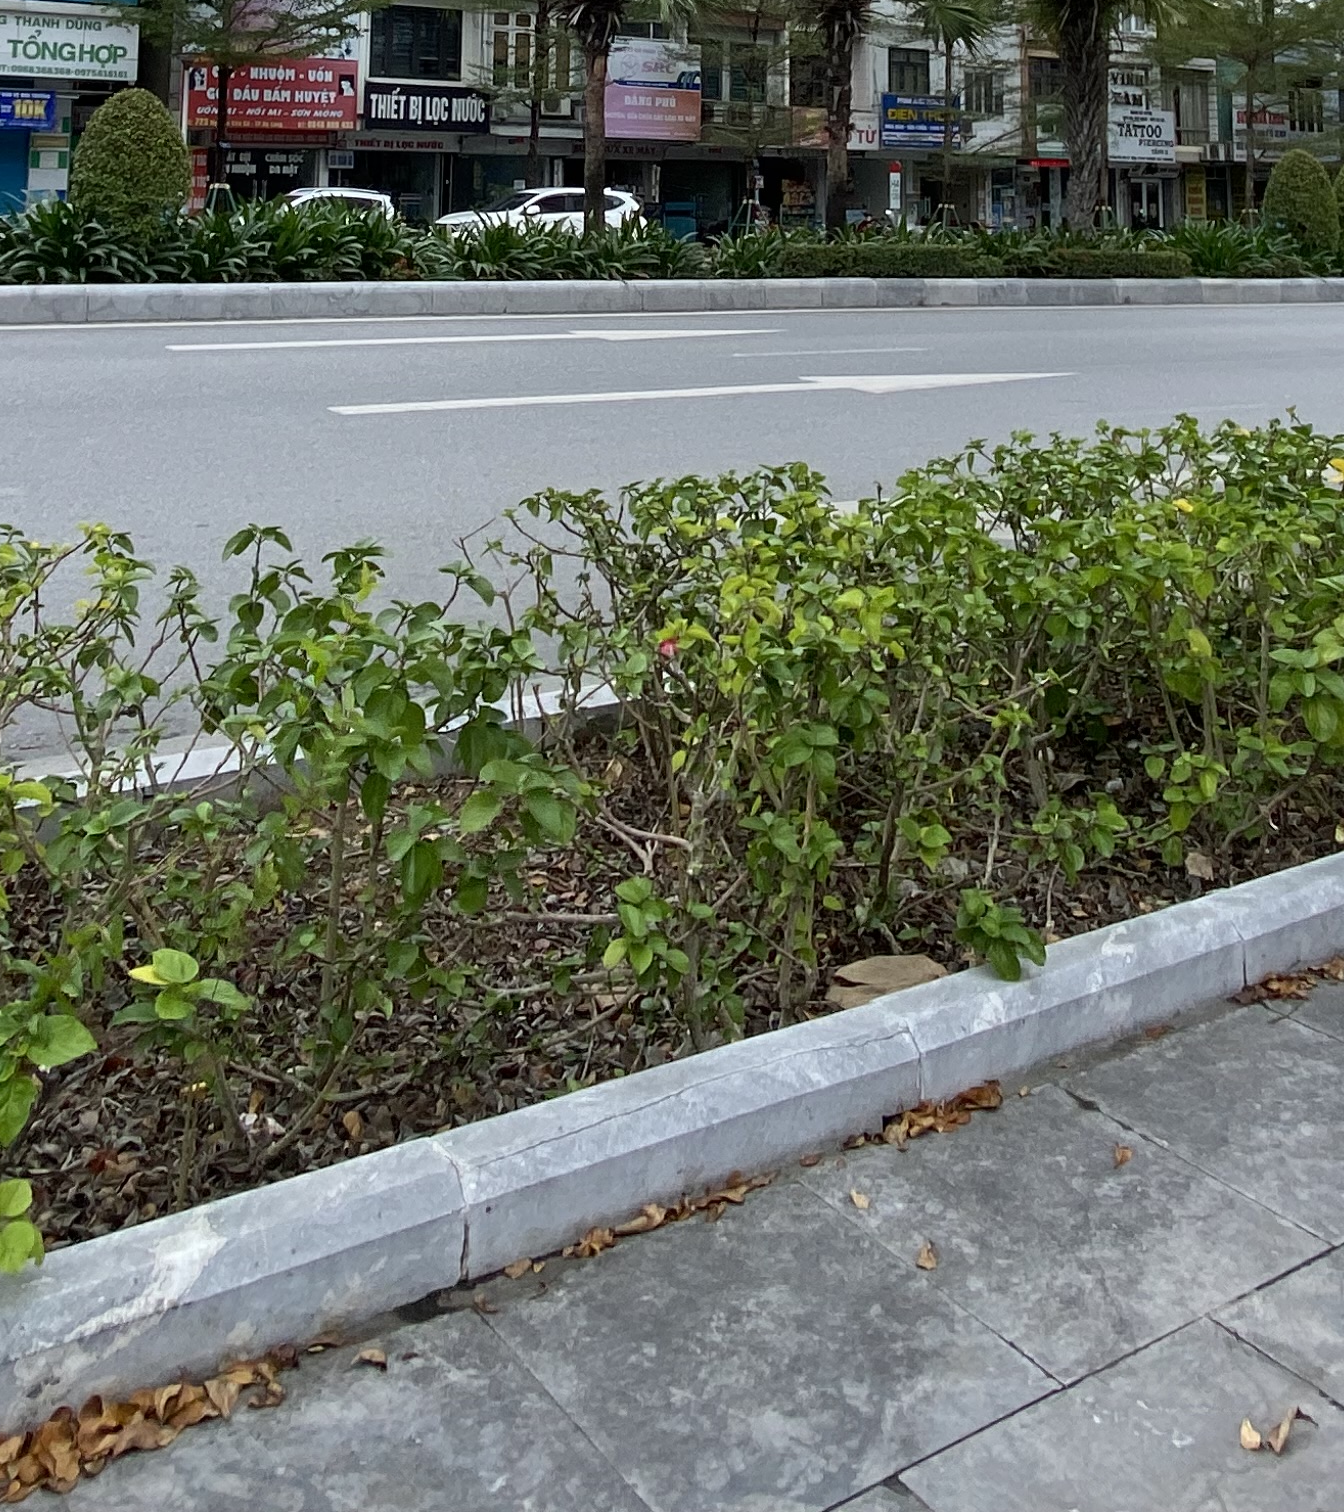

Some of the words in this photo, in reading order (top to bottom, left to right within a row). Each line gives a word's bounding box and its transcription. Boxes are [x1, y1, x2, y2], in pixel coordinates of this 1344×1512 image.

[14, 14, 61, 30] THANH
[65, 17, 103, 32] DŨNG
[369, 87, 407, 121] THIẾT
[409, 95, 423, 125] BỊ
[425, 95, 449, 126] LỌC
[451, 92, 486, 123] NƯỚC
[1117, 123, 1163, 139] TATTOO
